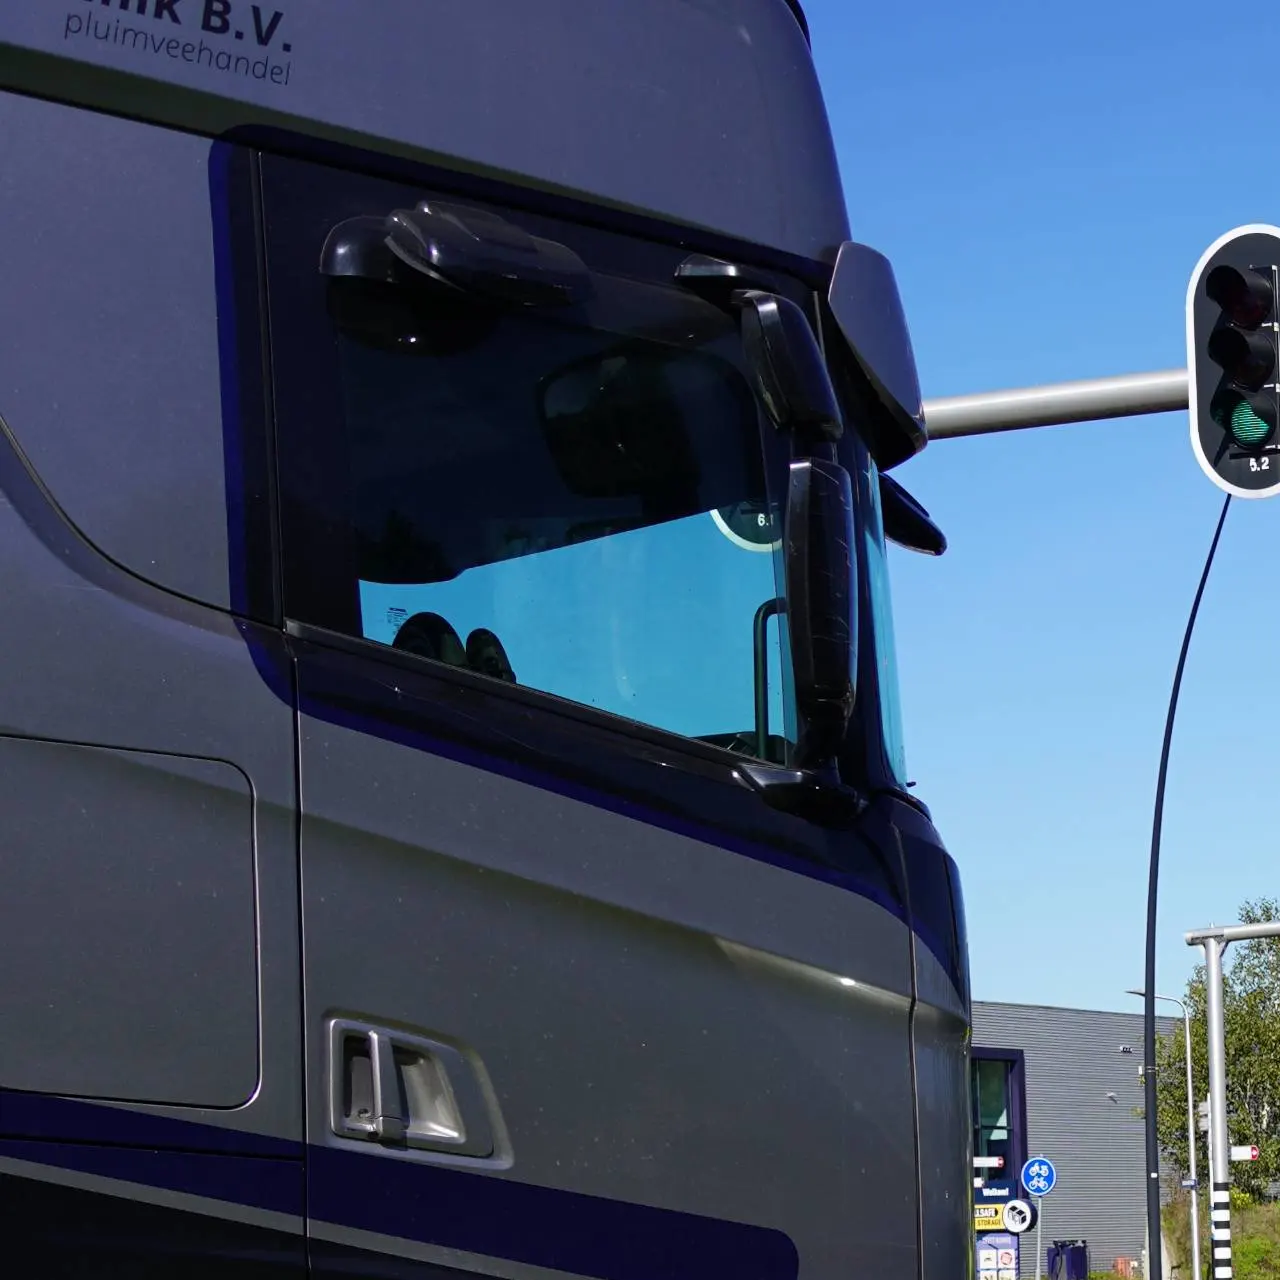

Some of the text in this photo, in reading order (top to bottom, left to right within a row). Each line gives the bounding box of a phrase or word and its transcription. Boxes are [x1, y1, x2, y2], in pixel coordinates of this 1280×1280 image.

[201, 0, 292, 52] B.V.
[64, 11, 291, 86] pluimveehandel
[1249, 456, 1270, 471] 5.2
[757, 512, 774, 527] 6.1
